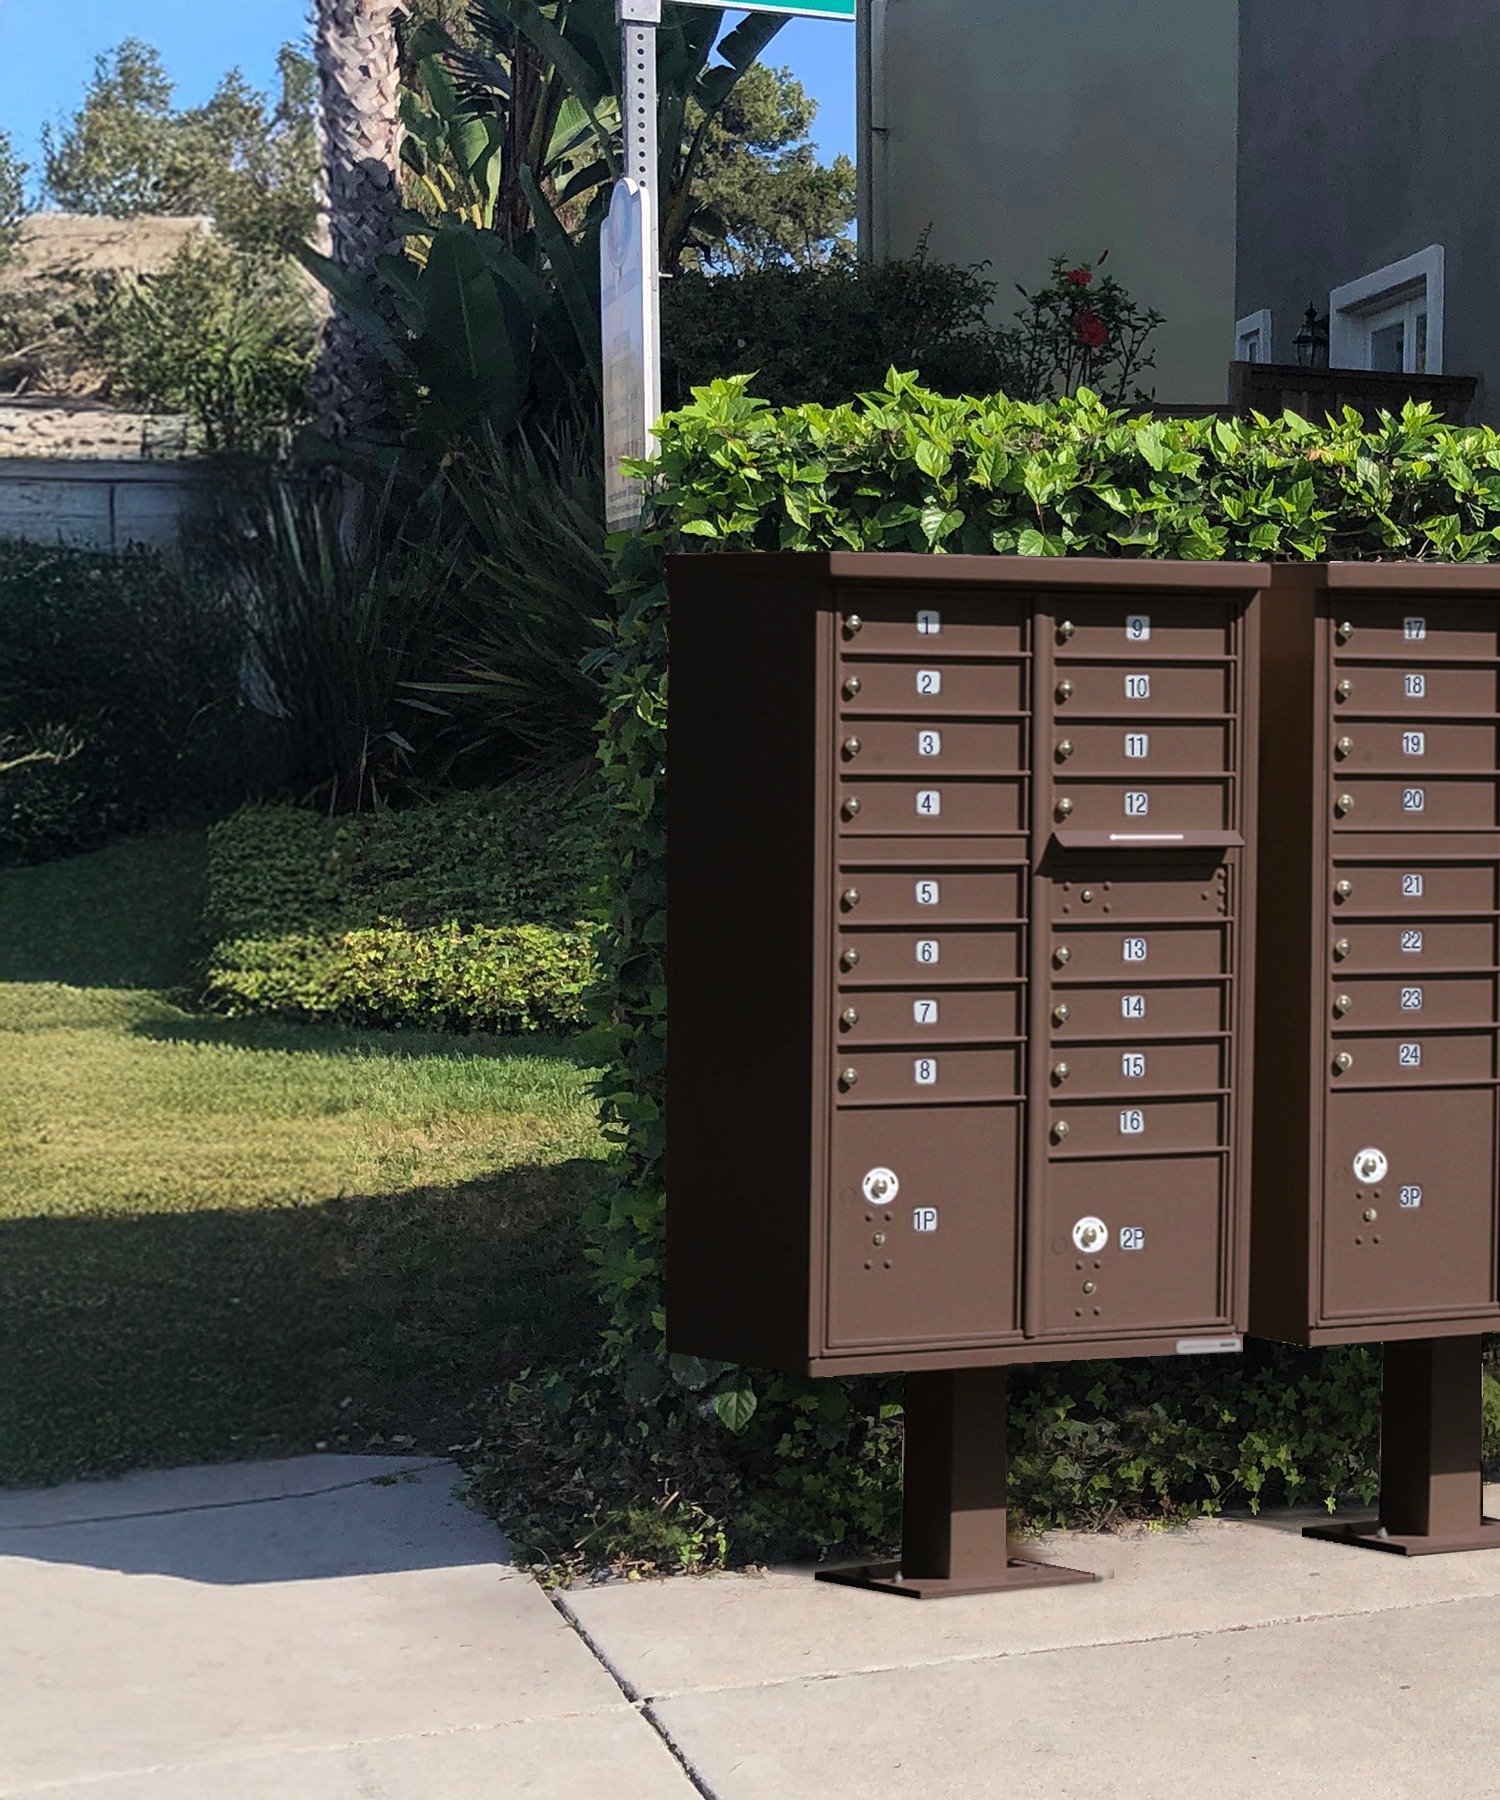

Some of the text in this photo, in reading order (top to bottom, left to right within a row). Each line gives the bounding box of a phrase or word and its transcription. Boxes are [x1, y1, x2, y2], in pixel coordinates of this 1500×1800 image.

[922, 616, 930, 635] 1
[1132, 620, 1143, 638] 9
[1406, 620, 1423, 638] 17
[921, 675, 932, 694] 2
[1128, 678, 1147, 697] 10
[1405, 677, 1422, 694] 18
[923, 735, 934, 754] 3
[1128, 737, 1145, 755] 11
[1403, 736, 1421, 753] 19
[921, 794, 932, 812] 4
[1127, 794, 1146, 813] 12
[1403, 791, 1422, 809] 20
[921, 884, 932, 903] 5
[1403, 876, 1420, 894] 21
[1125, 939, 1145, 959] 13
[1402, 932, 1420, 949] 22
[921, 943, 932, 962] 6
[1124, 997, 1143, 1016] 14
[1402, 990, 1421, 1008] 23
[919, 1003, 930, 1022] 7
[1401, 1045, 1420, 1063] 24
[919, 1061, 930, 1080] 8
[1124, 1057, 1143, 1076] 15
[1121, 1112, 1140, 1130] 16
[1400, 1187, 1420, 1206] 3P
[914, 1210, 935, 1230] 1P
[1123, 1229, 1145, 1248] 2P
